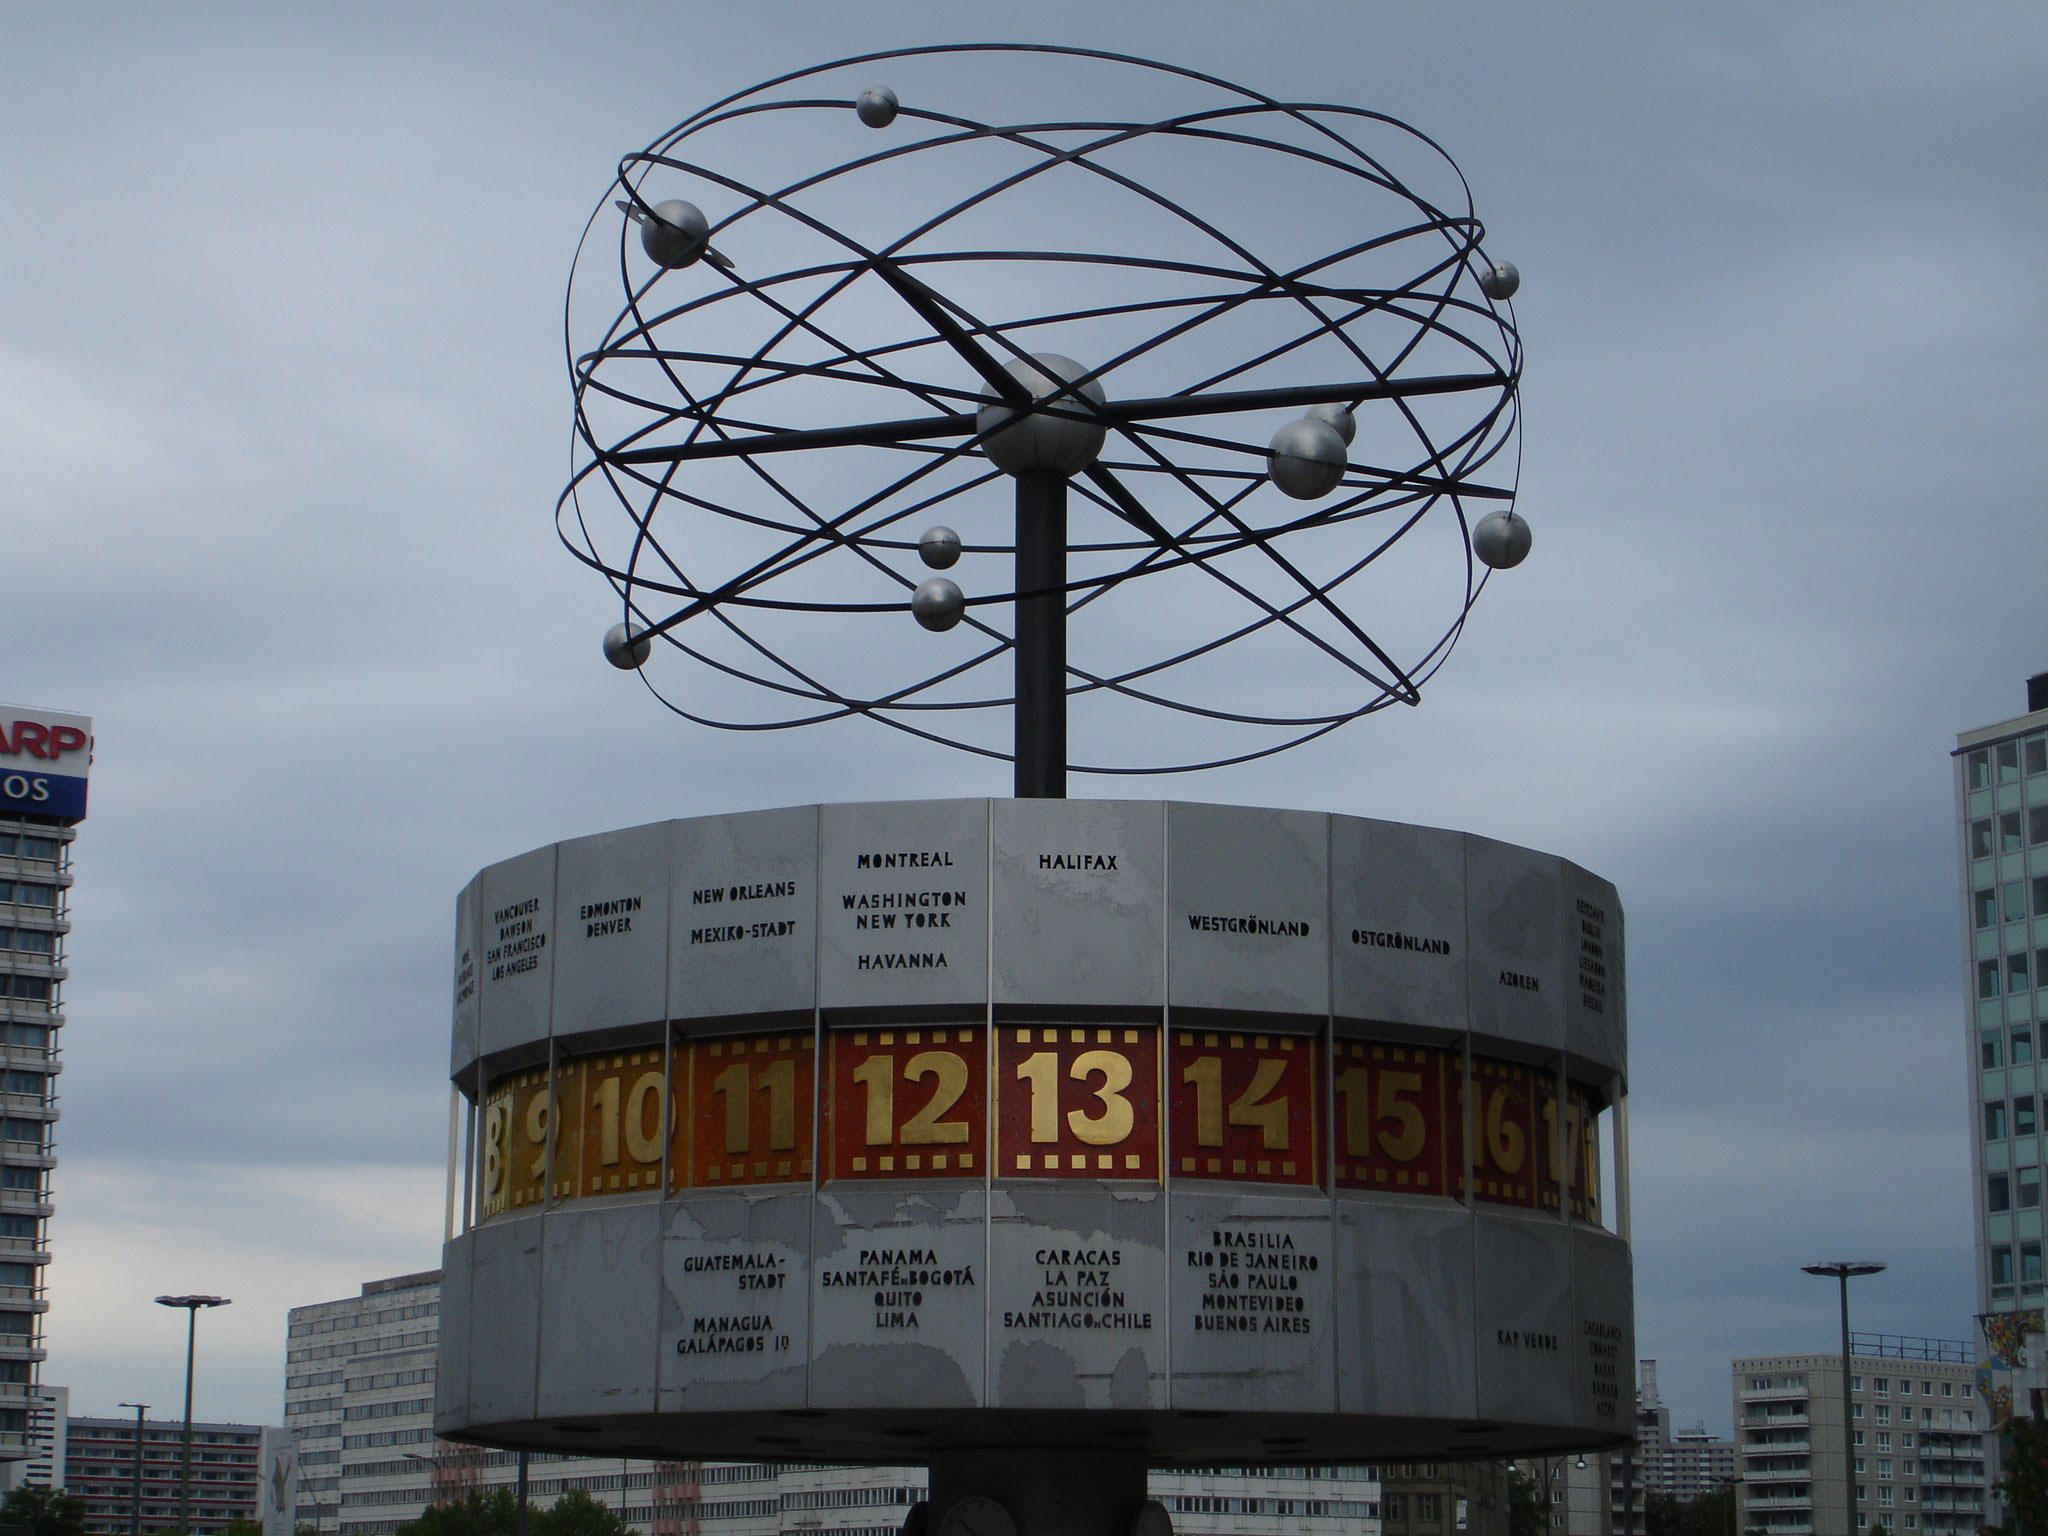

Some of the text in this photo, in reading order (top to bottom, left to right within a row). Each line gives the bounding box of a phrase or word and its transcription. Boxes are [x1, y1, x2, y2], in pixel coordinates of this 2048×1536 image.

[4, 775, 50, 801] OS
[857, 852, 953, 869] MONTREAL
[1039, 854, 1118, 870] HALIFAX
[692, 881, 796, 905] NEW ORLEANS
[842, 891, 966, 909] WASHINGTON
[494, 898, 539, 924] VANCOUVER
[580, 896, 642, 920] EDMONTON
[500, 919, 532, 941] DAWSON
[586, 917, 632, 938] DENVER
[856, 913, 951, 929] NEW YORK
[1188, 914, 1310, 937] WESTGRÖNLAND
[691, 920, 796, 945] MEXIKO-STADT
[1351, 929, 1451, 955] OSTGRÖNLAND
[487, 946, 501, 965] SAN
[503, 933, 546, 959] FRANCISCO
[492, 964, 505, 981] LOS
[506, 955, 538, 978] ANGELES
[858, 953, 947, 970] HAVANNA
[1499, 970, 1540, 993] AZOREN
[713, 1059, 795, 1155] 11
[853, 1051, 969, 1146] 12
[1016, 1050, 1135, 1146] 13
[1183, 1056, 1290, 1151] 14
[593, 1071, 677, 1167] 10
[1335, 1065, 1426, 1162] 15
[526, 1089, 561, 1180] 9
[1457, 1079, 1526, 1175] 16
[1542, 1096, 1581, 1188] 17
[1212, 1231, 1294, 1249] BRASILIA
[684, 1252, 786, 1272] GUATEMALA-
[859, 1249, 938, 1265] PANAMA
[1035, 1249, 1121, 1266] CARACAS
[1187, 1251, 1319, 1271] RIO DE JANEIRO
[739, 1273, 786, 1290] STADT
[1045, 1270, 1110, 1287] LA PAZ
[1208, 1270, 1298, 1290] SÃO PAULO
[874, 1291, 923, 1308] QUITO
[1031, 1288, 1125, 1308] ASUNCIÓN
[1202, 1293, 1305, 1312] MONTEVIDEO
[693, 1315, 773, 1333] MANAGUA
[876, 1312, 920, 1328] LIMA
[1102, 1312, 1152, 1330] CHILE
[1194, 1315, 1311, 1334] BUENOS AIRES
[677, 1333, 764, 1354] GALÁPAGOS
[1497, 1330, 1558, 1351] KAP VERDE
